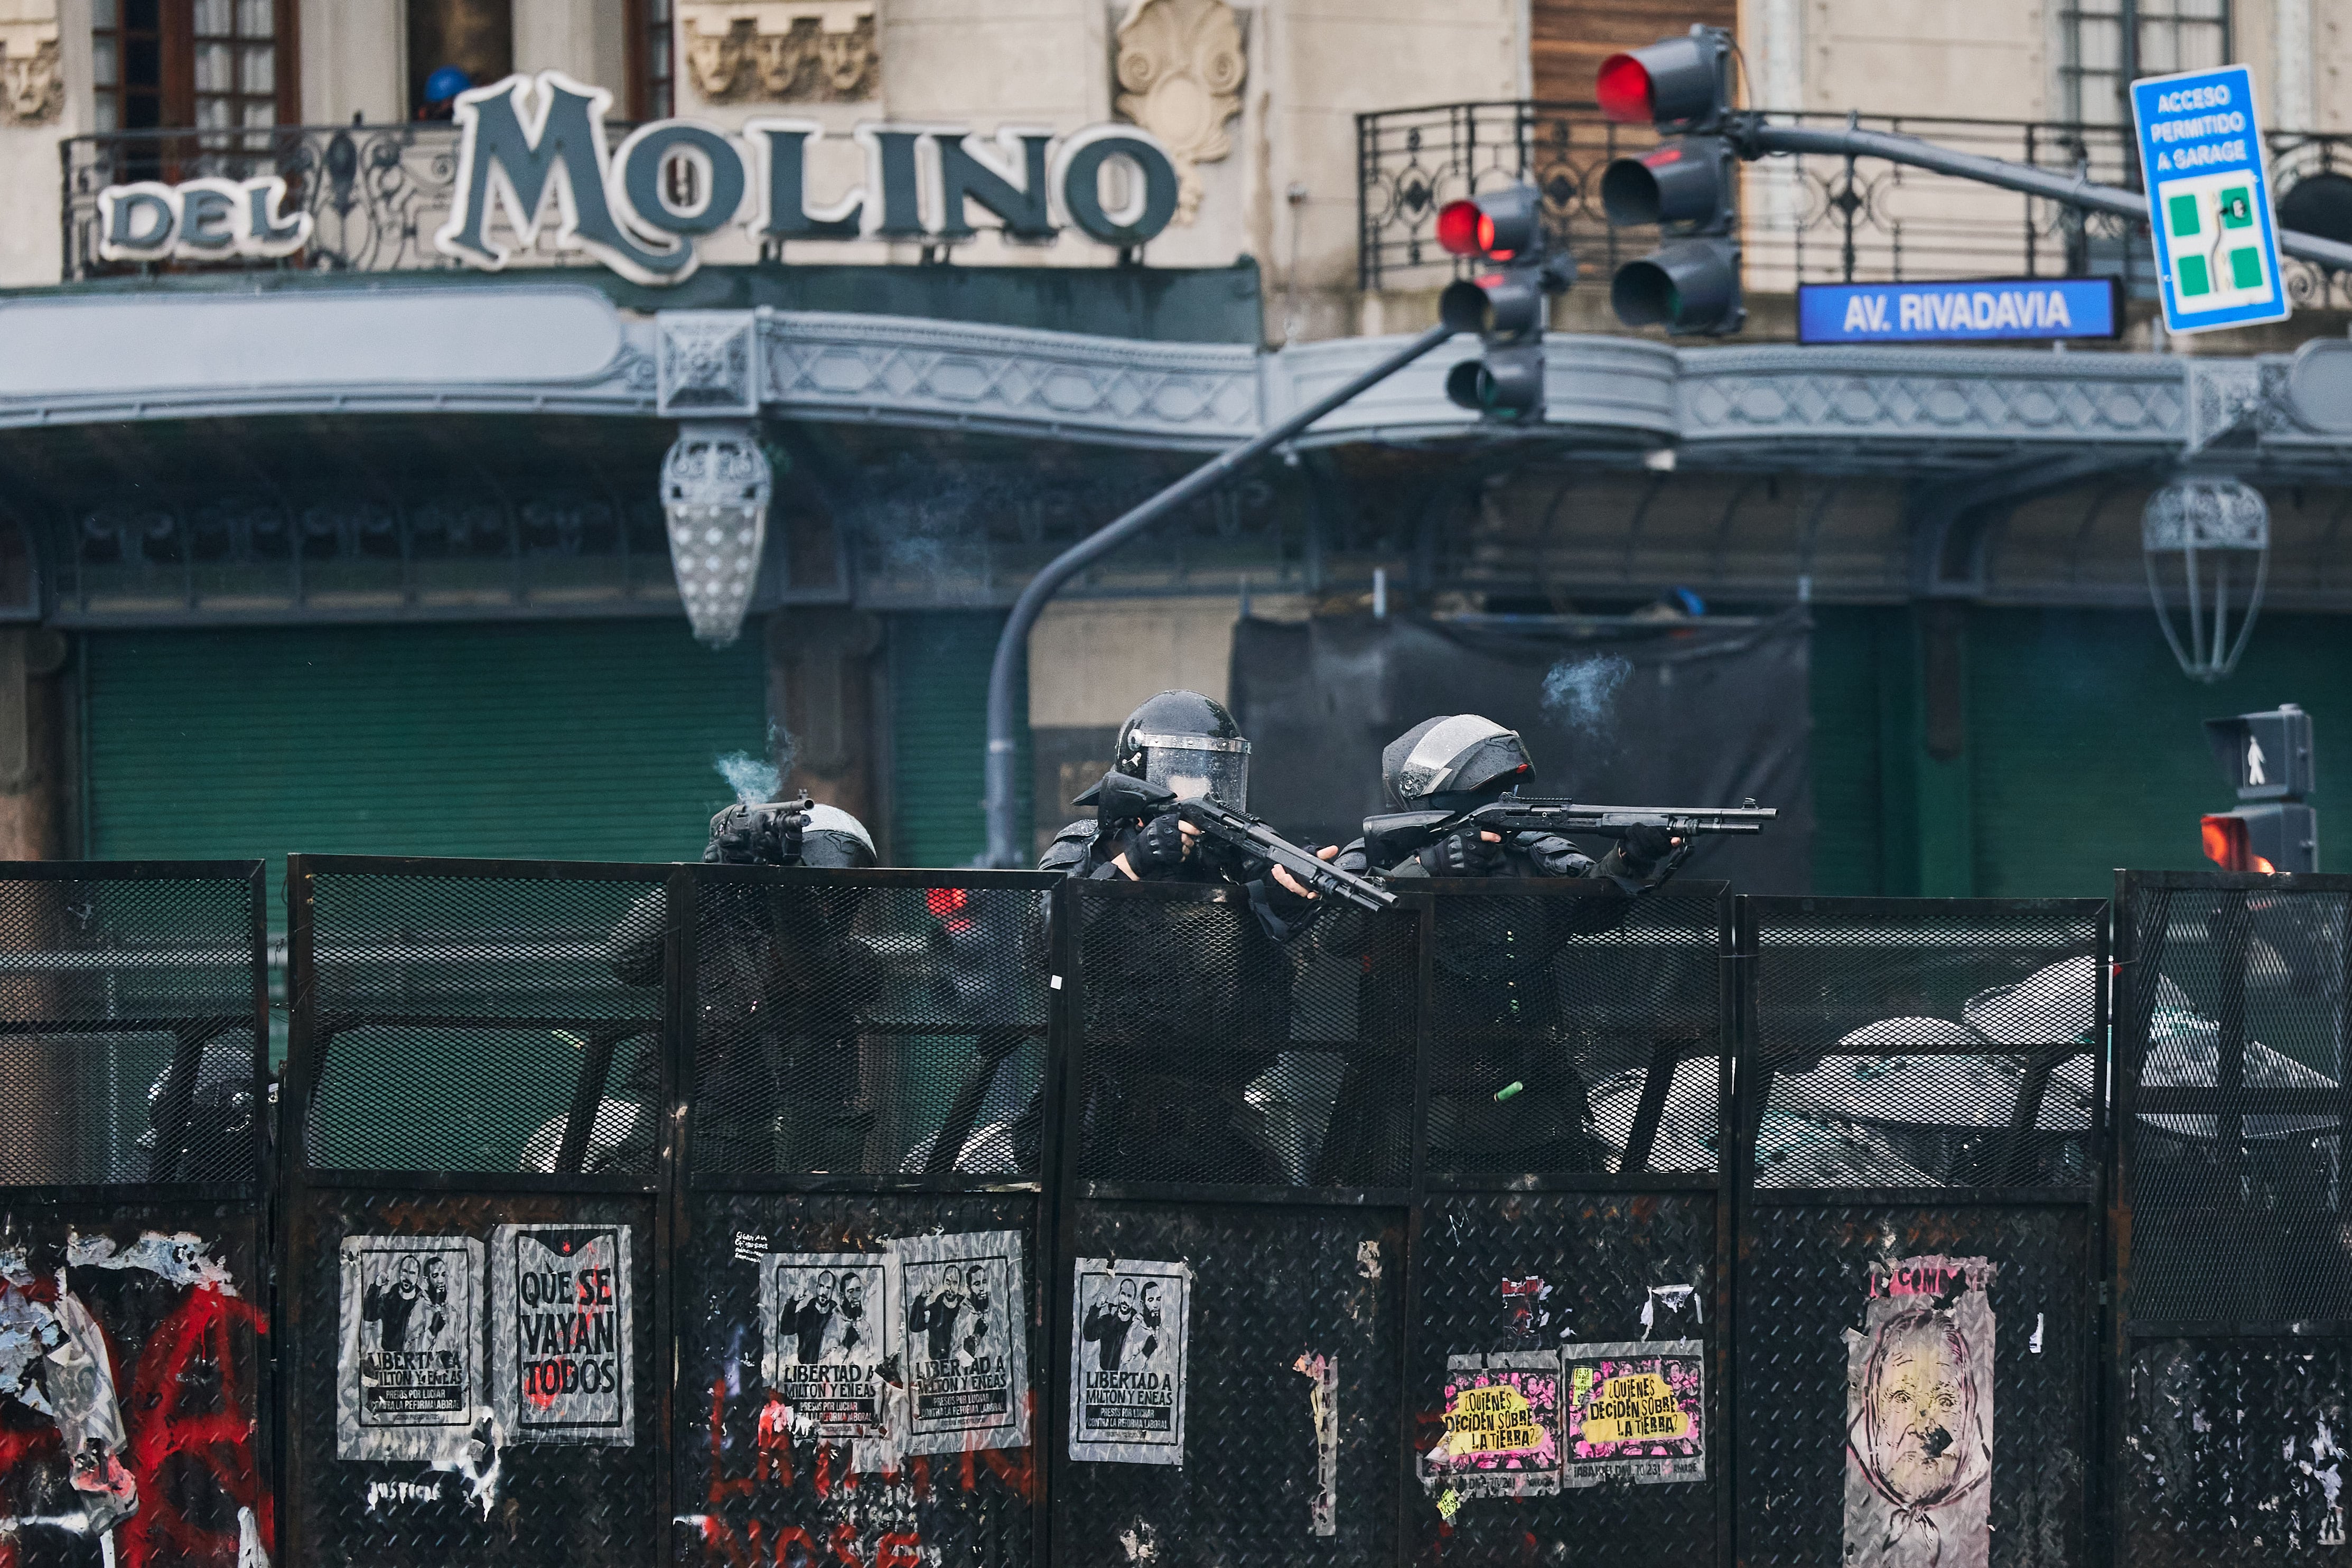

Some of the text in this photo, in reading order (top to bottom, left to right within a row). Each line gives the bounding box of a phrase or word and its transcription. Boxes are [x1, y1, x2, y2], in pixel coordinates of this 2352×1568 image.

[2158, 84, 2232, 114] ACCESO
[2151, 110, 2245, 143] PERMITIDO
[2157, 139, 2247, 171] A GARAGE
[99, 71, 1178, 284] DEL MOLINO
[1843, 290, 2071, 332] AV. RIVADAVIA
[521, 1268, 613, 1308] QUE SE
[521, 1311, 614, 1355] VAYAN
[783, 1364, 862, 1383] LIBERTAD
[995, 1355, 1006, 1373] A
[522, 1358, 615, 1395] TODOS
[960, 1377, 968, 1390] Y
[972, 1374, 1006, 1390] ENEAS
[1086, 1371, 1172, 1391] LIBERTAD A
[408, 1389, 421, 1399] POR
[784, 1383, 876, 1398] MILTON Y ENEAS
[933, 1393, 989, 1407] PRESOS POR LUCHAR
[1086, 1389, 1173, 1406] MILTON Y ENEAS
[800, 1401, 858, 1411] PRESOS POR LUCHAR
[1101, 1407, 1121, 1417] PRESOS
[1133, 1409, 1154, 1418] LUCHAR
[1641, 1394, 1676, 1416] SOBRE
[1087, 1417, 1168, 1429] CONTRA LA REFORMA LABORAL
[1498, 1408, 1533, 1430] SOBRE
[1617, 1420, 1633, 1437] LA
[1472, 1433, 1487, 1450] LA
